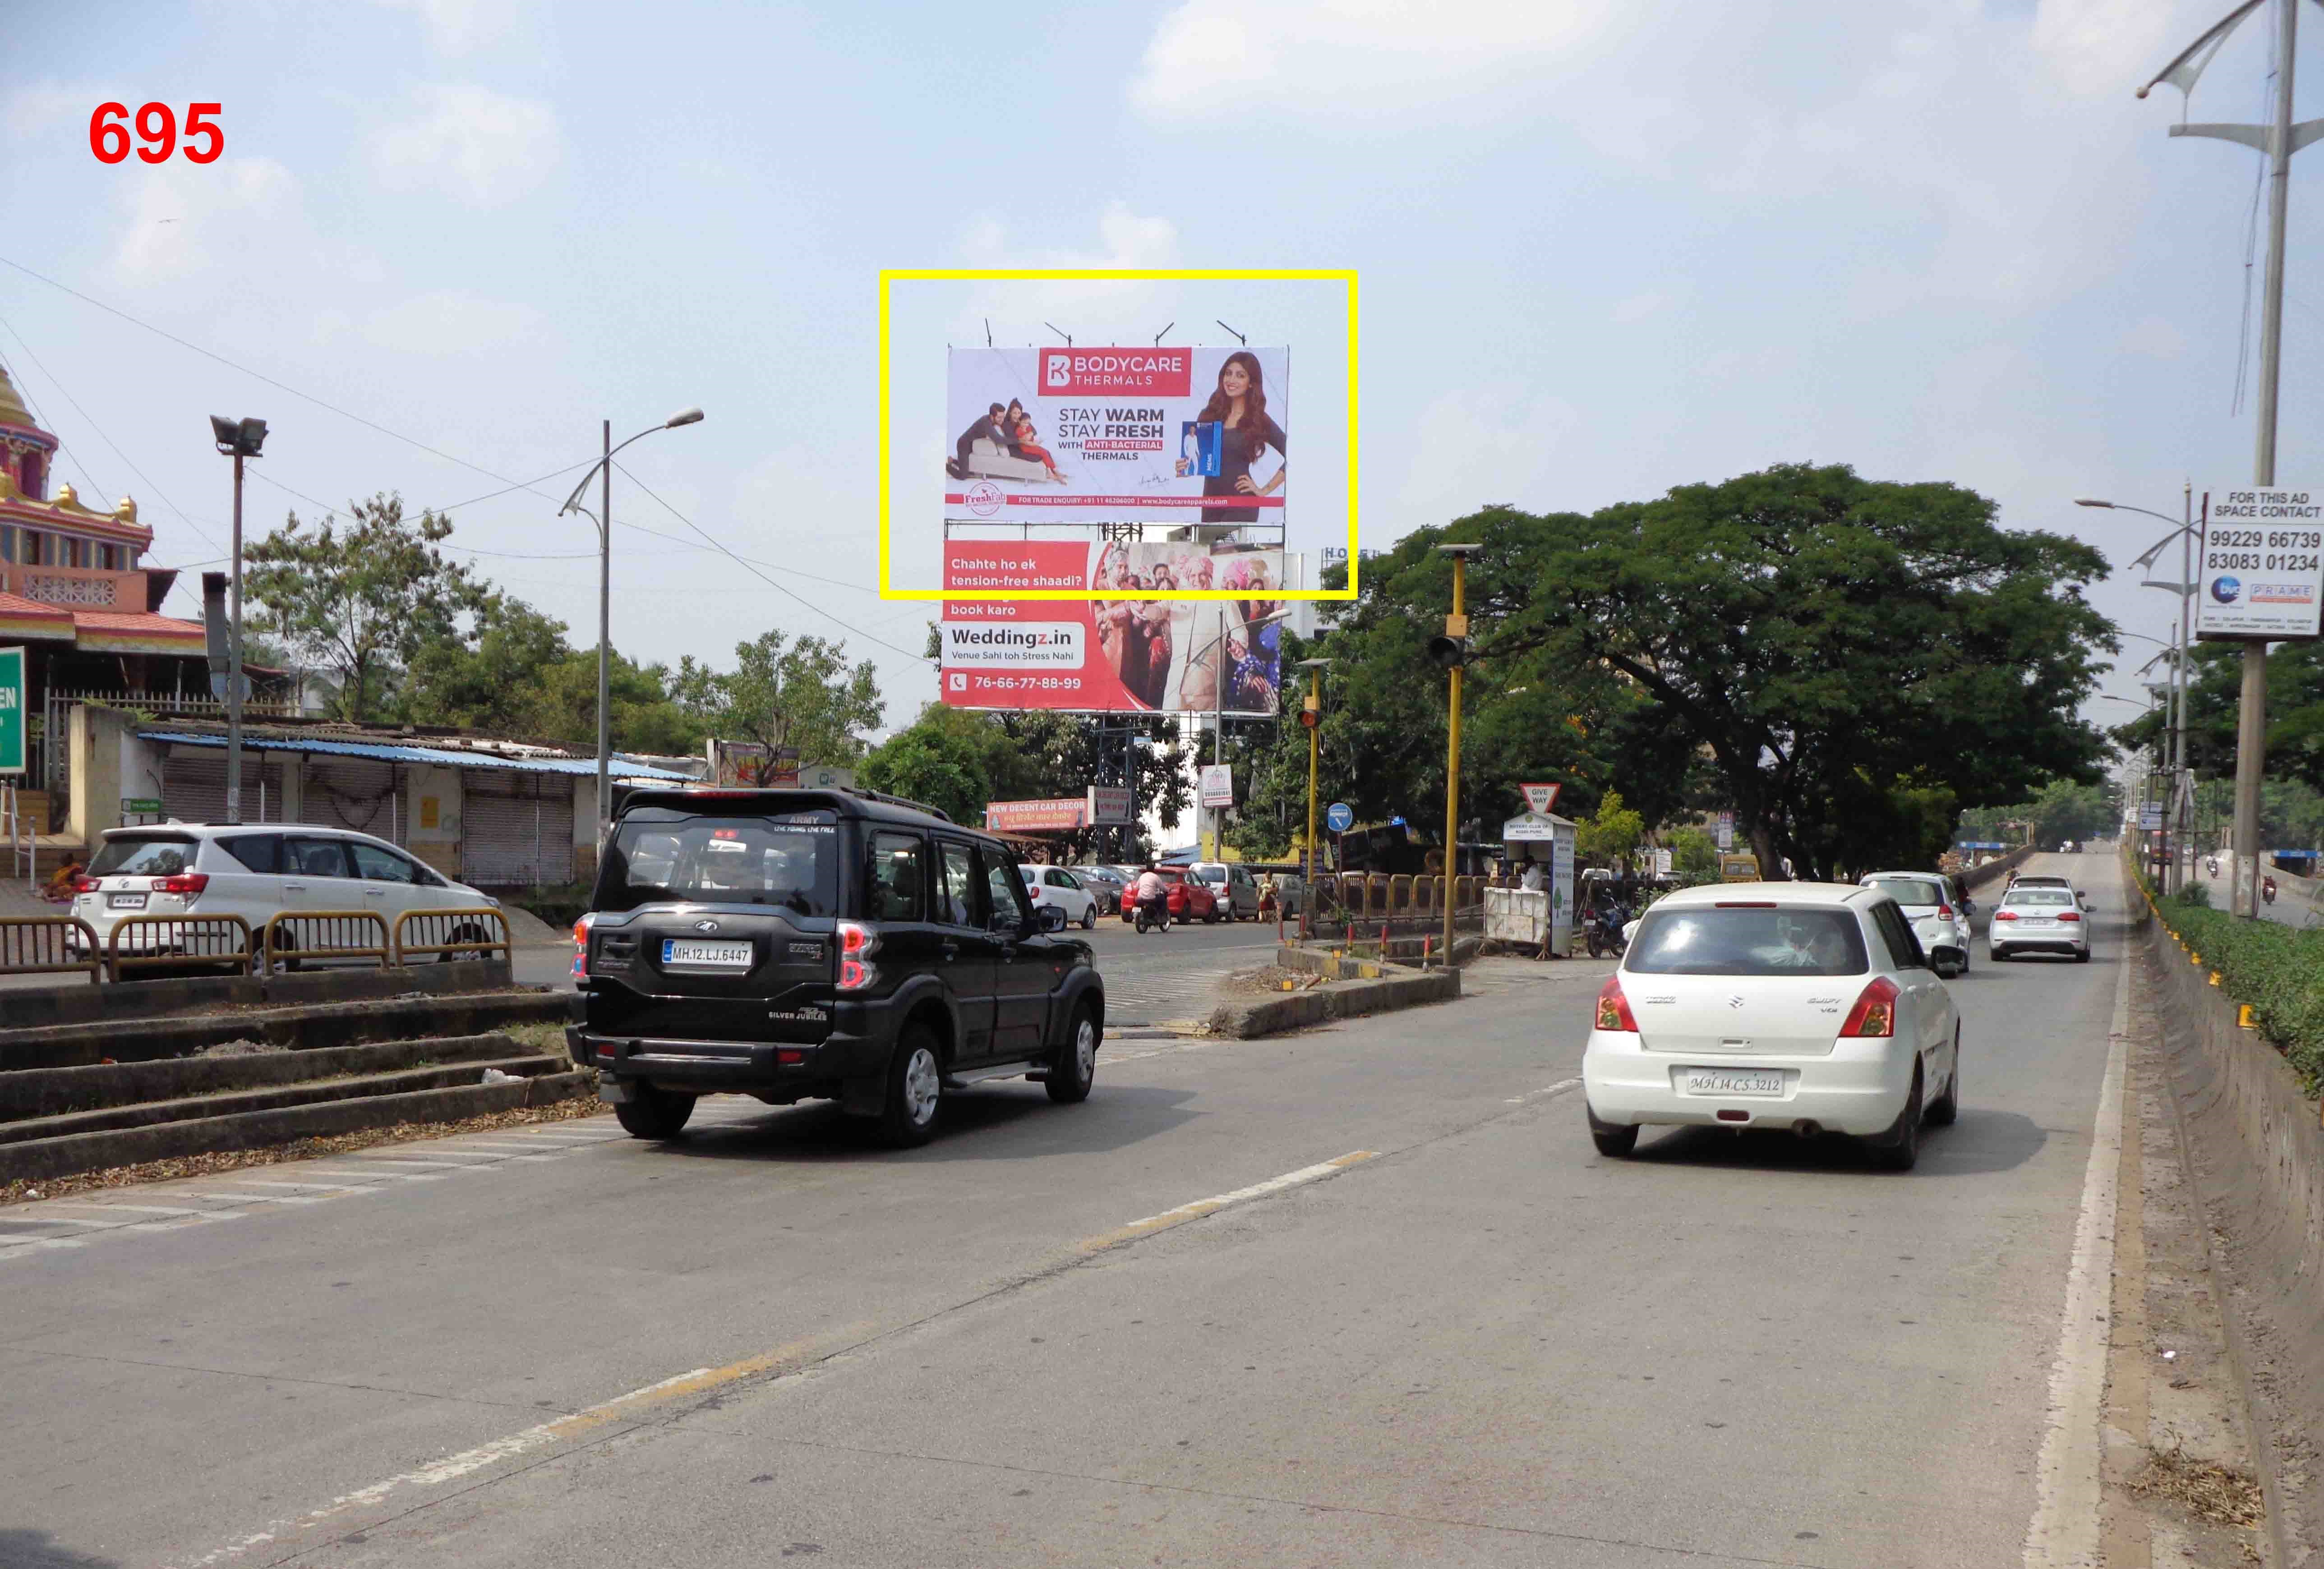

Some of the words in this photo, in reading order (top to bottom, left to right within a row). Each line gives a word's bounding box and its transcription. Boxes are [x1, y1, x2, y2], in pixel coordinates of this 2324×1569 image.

[1074, 356, 1182, 372] BODYCARE
[1075, 375, 1153, 385] THERMALS
[1059, 409, 1101, 422] STAY
[1106, 409, 1164, 422] WARM
[1059, 425, 1100, 437] STAY
[1105, 425, 1163, 438] FRESH
[1086, 441, 1162, 449] ANTI-BACTERIAL
[2229, 492, 2255, 504] FOR
[2259, 492, 2287, 504] THIS
[2290, 493, 2310, 504] AD
[2215, 506, 2257, 517] SPACE
[2260, 506, 2321, 518] CONTACT
[2210, 531, 2262, 547] 99229
[2269, 532, 2321, 548] 66739
[951, 559, 996, 570] Chahte
[1001, 559, 1016, 570] ho
[1021, 559, 1036, 570] ek
[2208, 553, 2260, 570] 83083
[2266, 554, 2319, 571] 01234
[951, 575, 1028, 586] tension-free
[1033, 575, 1082, 587] shaadi?
[2253, 586, 2310, 596] PRAME
[951, 604, 983, 615] book
[987, 604, 1016, 616] karo
[952, 629, 1071, 649] Weddingz.in
[952, 651, 980, 660] Venue
[982, 651, 1002, 660] Sahi
[1004, 652, 1019, 660] toh
[1022, 652, 1050, 661] Stress
[1052, 652, 1074, 661] Nahi
[974, 676, 1081, 689] 76-66-77-88-99
[673, 947, 748, 961] MH.12.LJ.6447
[769, 1011, 794, 1020] SILVER
[796, 1012, 827, 1021] JUBILEE
[1691, 1077, 1780, 1092] MH.14.CS.3212
